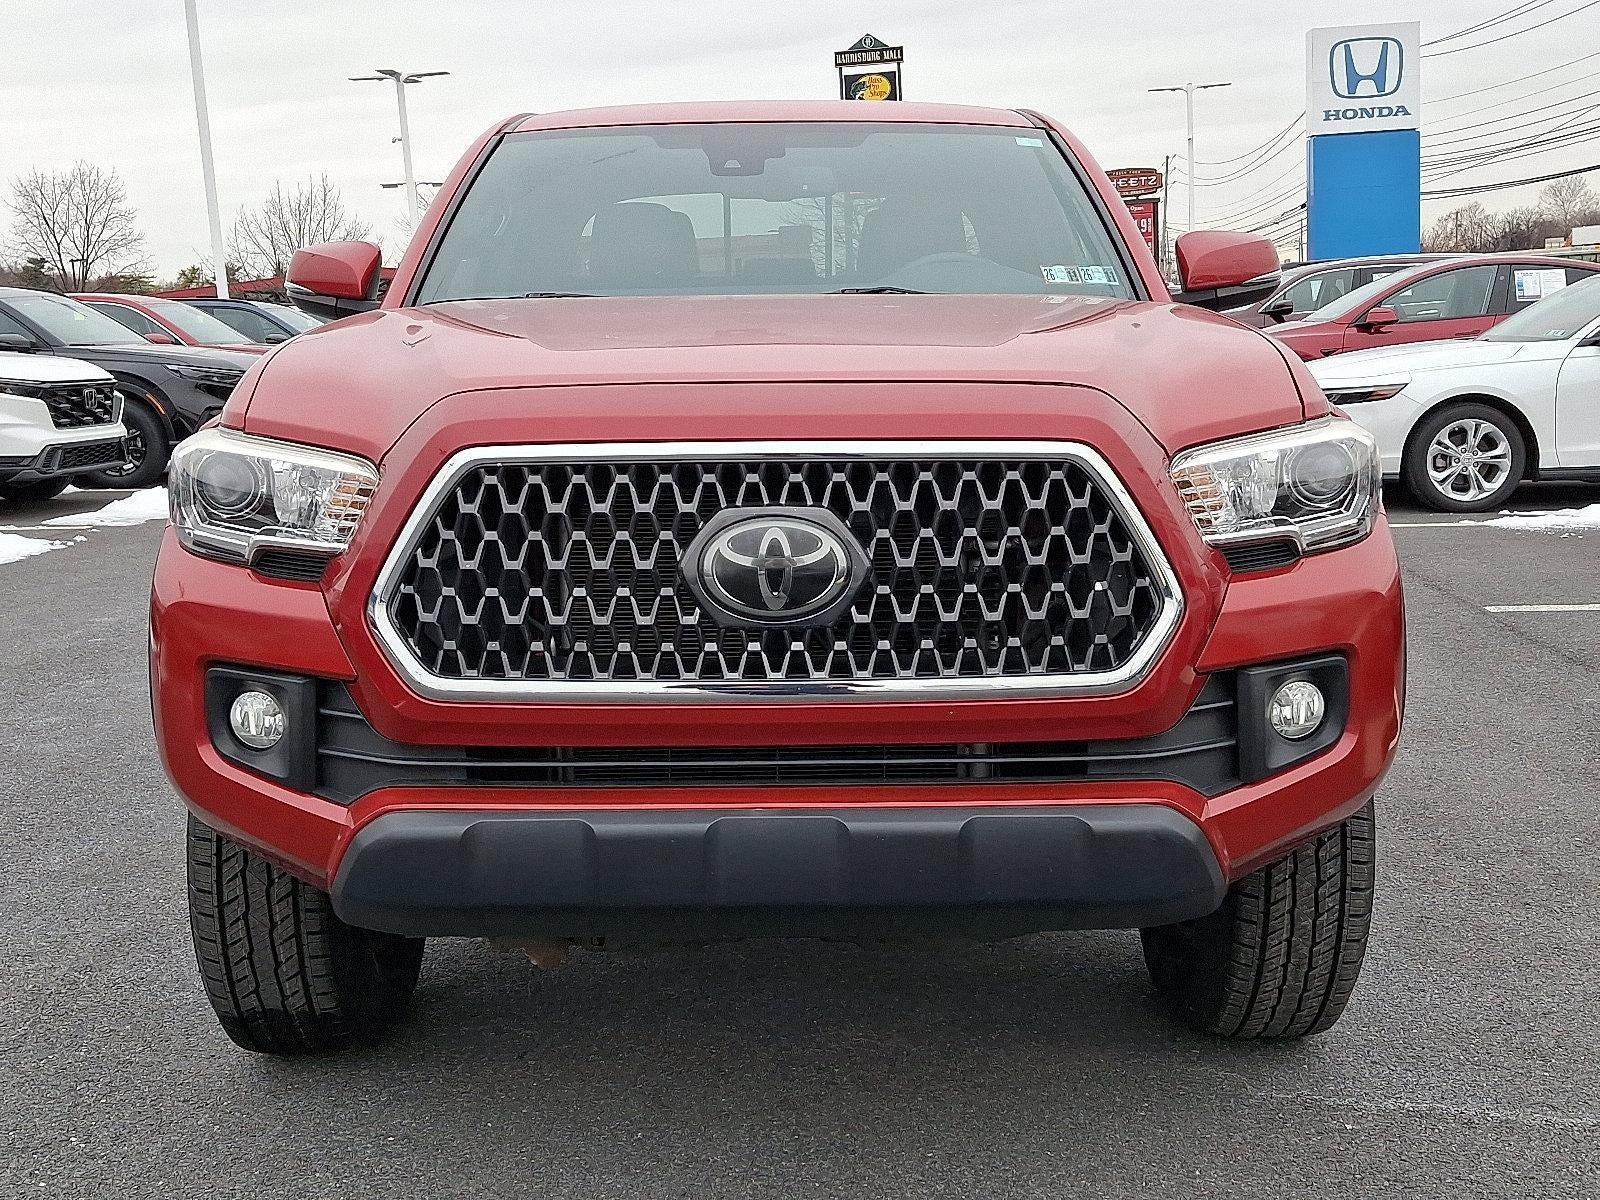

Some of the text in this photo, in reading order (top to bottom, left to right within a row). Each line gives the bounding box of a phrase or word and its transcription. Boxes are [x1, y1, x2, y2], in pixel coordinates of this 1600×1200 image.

[836, 49, 902, 64] HARRISBURG MALL
[1323, 105, 1411, 121] HONDA
[1111, 176, 1156, 187] HEETZ
[1043, 268, 1056, 281] 26
[1080, 268, 1093, 281] 26
